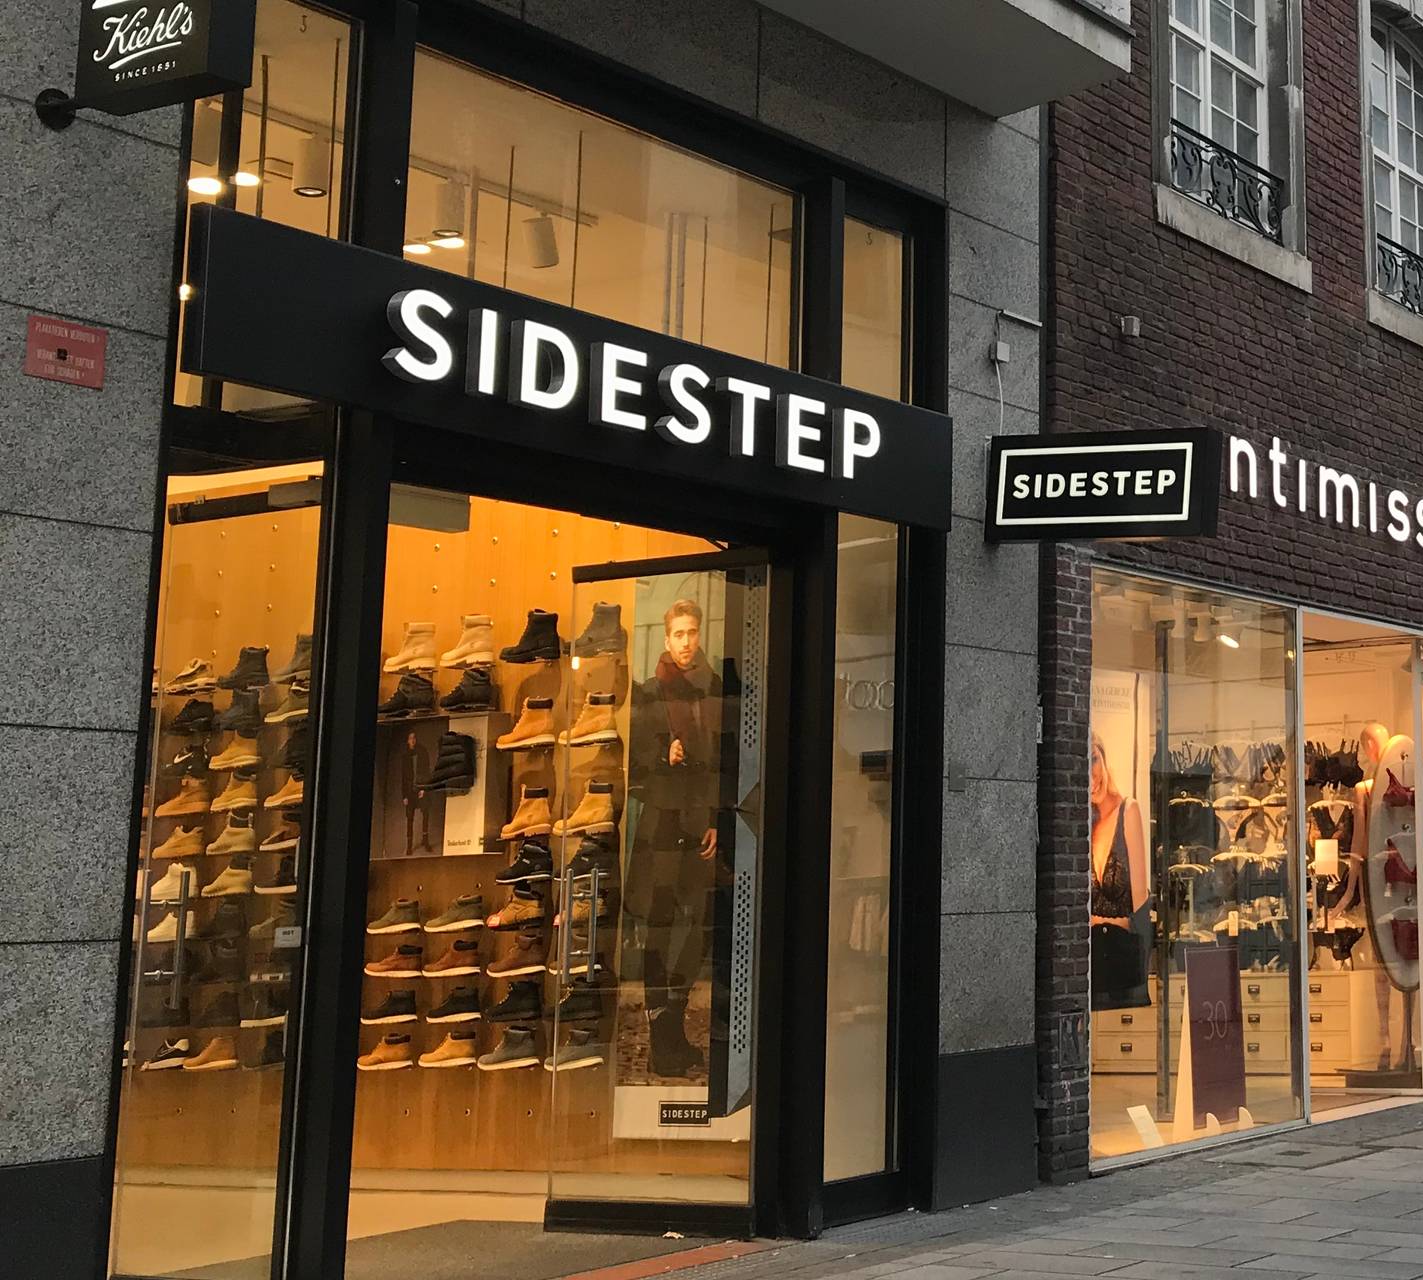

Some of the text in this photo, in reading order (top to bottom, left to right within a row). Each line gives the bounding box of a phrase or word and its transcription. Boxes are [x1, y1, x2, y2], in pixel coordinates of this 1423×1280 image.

[93, 2, 193, 61] Kiehl's
[115, 67, 148, 82] SINCE
[386, 288, 882, 479] SIDESTEP
[1012, 469, 1177, 499] SIDESTEP
[662, 1109, 708, 1119] SIDESTEP
